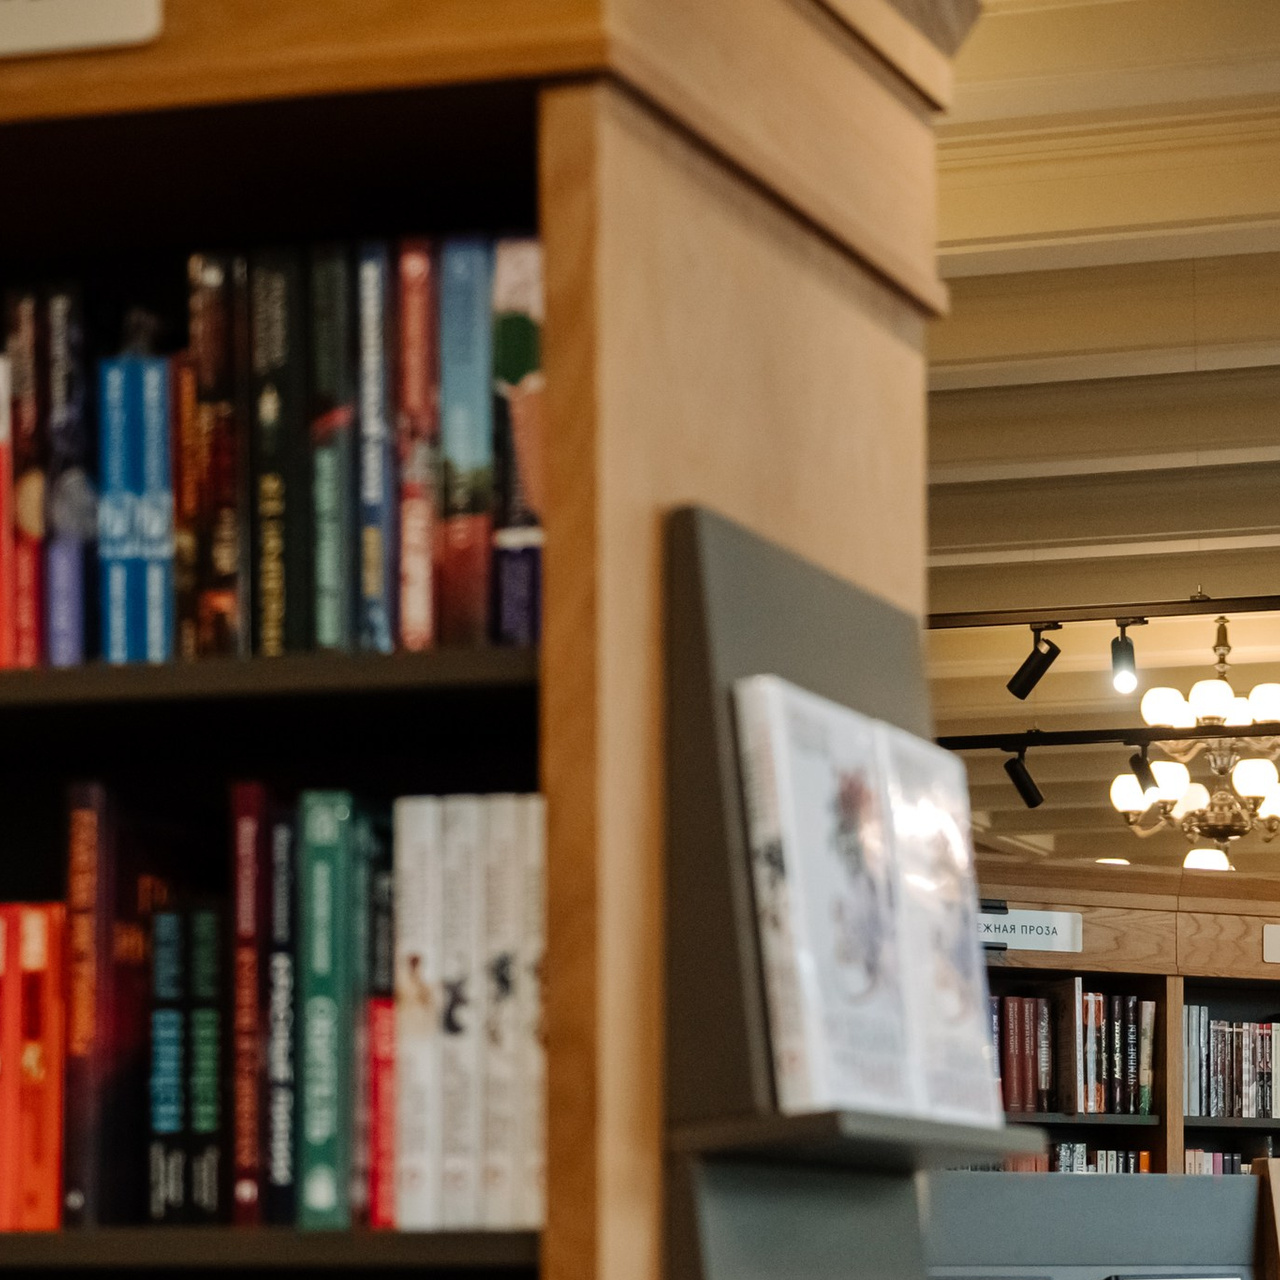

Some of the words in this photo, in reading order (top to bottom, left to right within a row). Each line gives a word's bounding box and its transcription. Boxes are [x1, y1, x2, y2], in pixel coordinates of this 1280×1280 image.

[976, 922, 1016, 934] ЕЖНАЯ
[1020, 924, 1058, 936] ПРОЗА
[1128, 1024, 1136, 1044] ПСЫ
[1128, 1046, 1136, 1084] ЧУМНЫЕ
